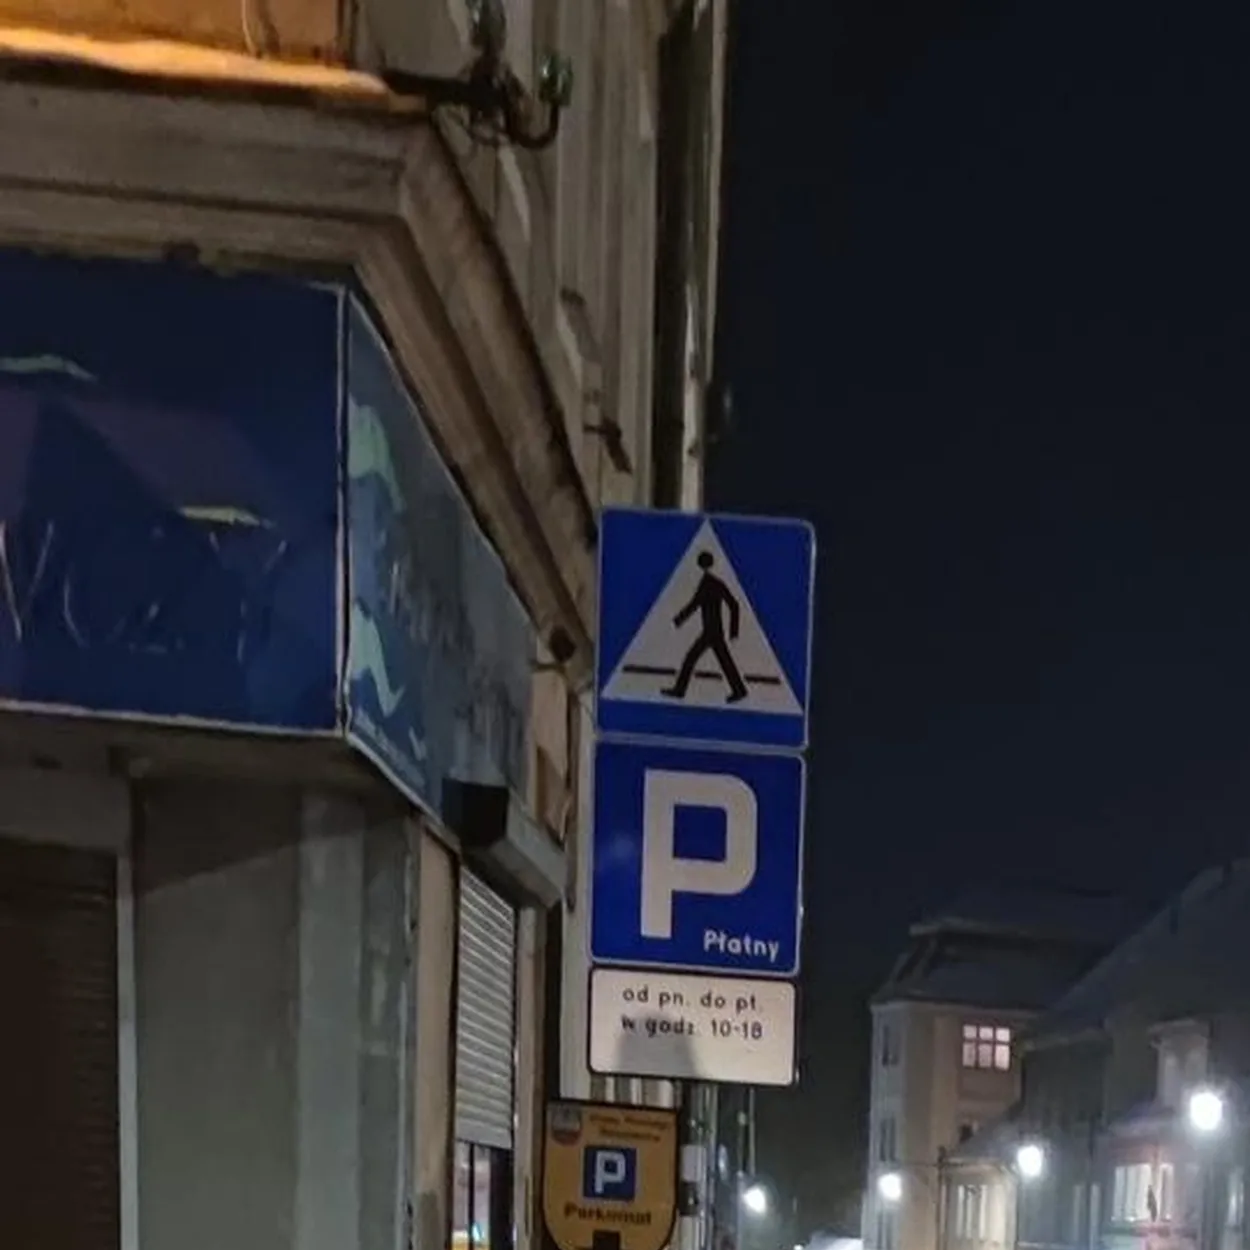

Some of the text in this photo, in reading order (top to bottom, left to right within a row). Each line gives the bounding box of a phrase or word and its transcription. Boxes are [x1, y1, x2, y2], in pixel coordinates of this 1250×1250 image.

[640, 768, 758, 940] P
[703, 928, 780, 964] Płatny
[622, 985, 649, 1003] od
[700, 990, 726, 1009] do
[711, 1018, 764, 1040] 10-18
[594, 1150, 627, 1194] P
